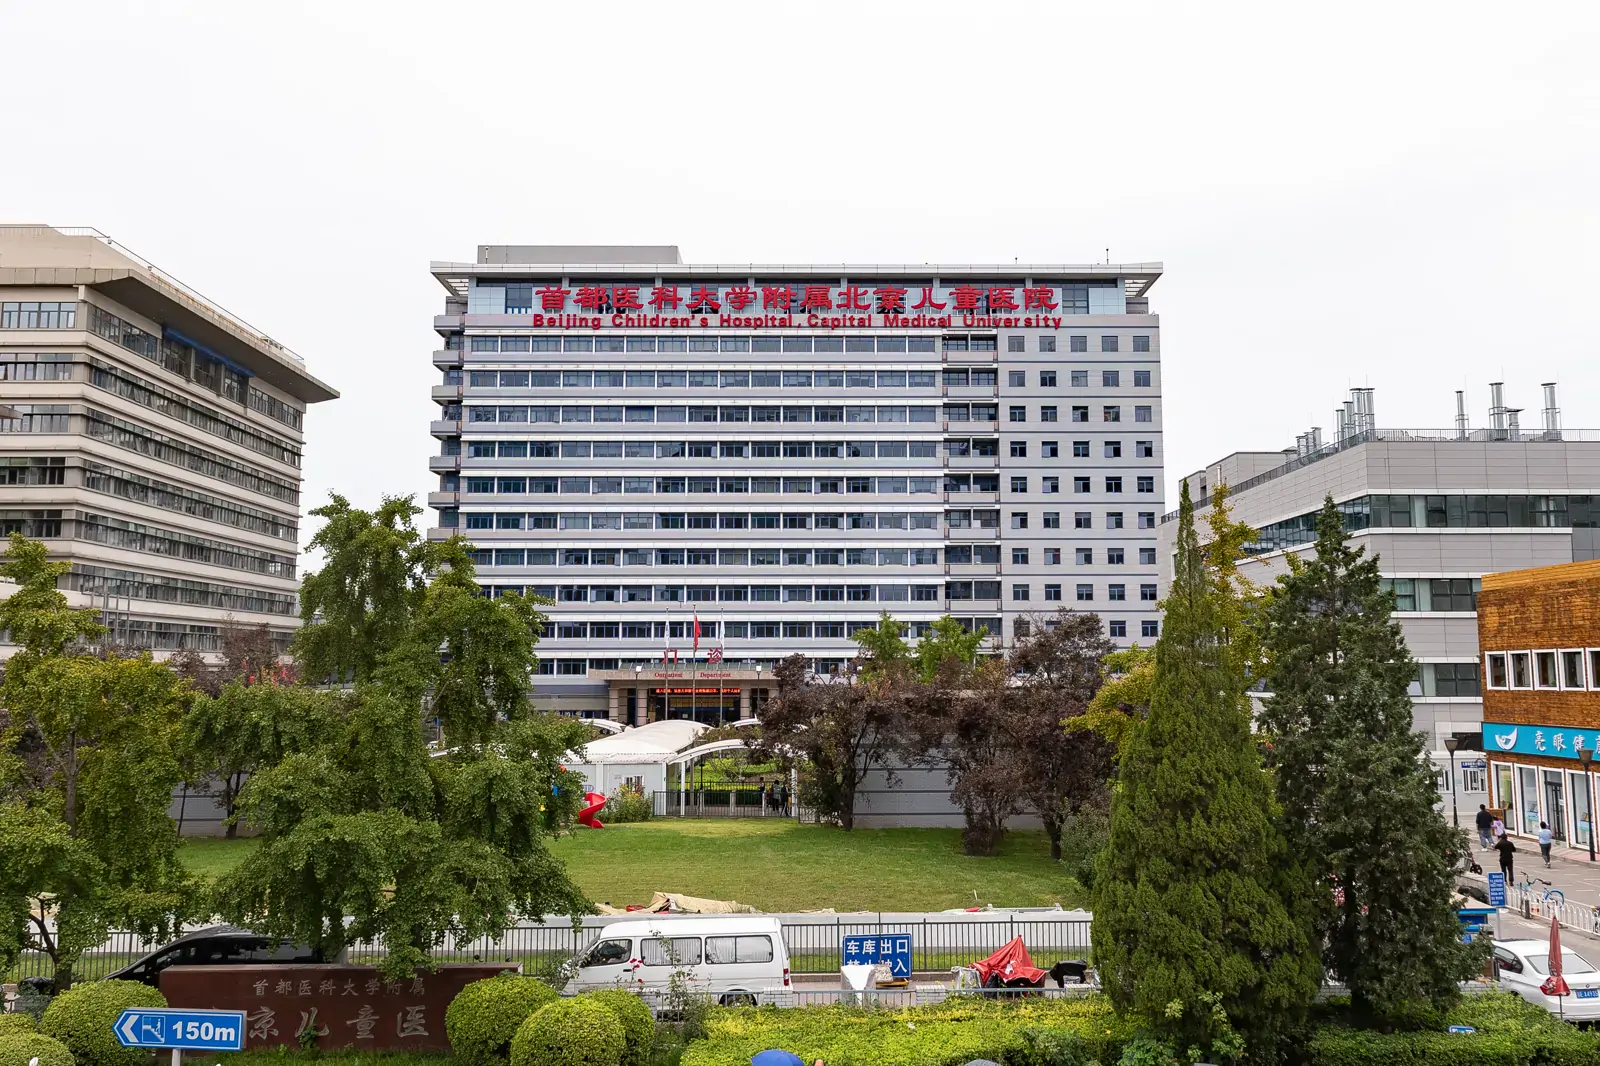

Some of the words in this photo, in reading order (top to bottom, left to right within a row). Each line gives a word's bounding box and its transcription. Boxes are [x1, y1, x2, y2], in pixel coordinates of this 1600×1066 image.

[535, 284, 1059, 310] 首都医科大学附属北京儿童医院
[533, 313, 602, 330] Beijing
[611, 313, 709, 328] Children's
[807, 313, 872, 330] Capital
[883, 313, 952, 328] Medical
[962, 313, 1062, 330] University
[654, 671, 683, 679] Outpatient
[700, 671, 732, 679] Department
[846, 938, 908, 956] 车库出口
[252, 977, 427, 996] 首都医科大学附属
[172, 1020, 236, 1042] 150m
